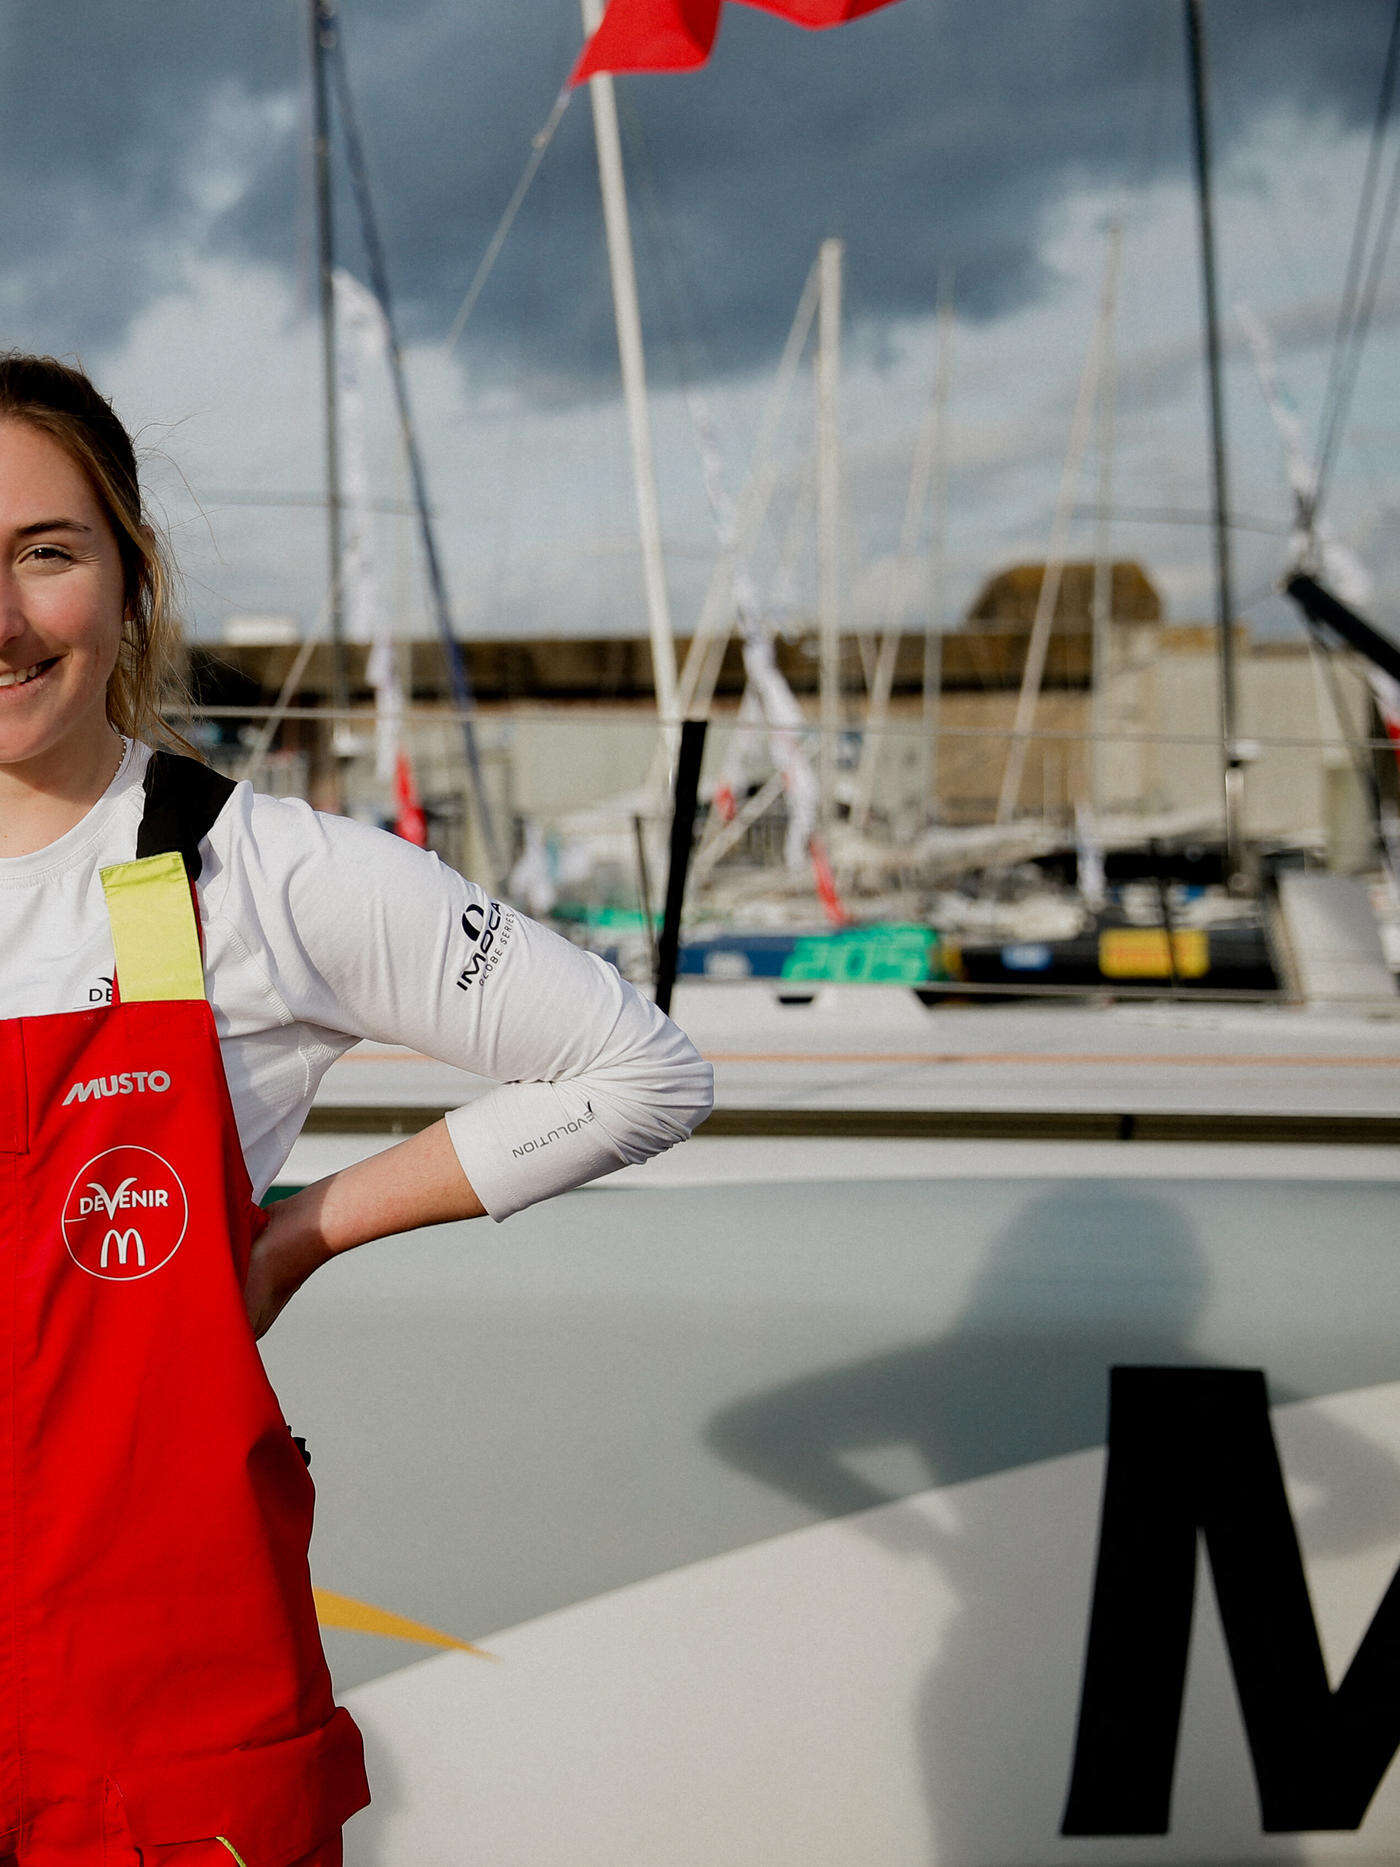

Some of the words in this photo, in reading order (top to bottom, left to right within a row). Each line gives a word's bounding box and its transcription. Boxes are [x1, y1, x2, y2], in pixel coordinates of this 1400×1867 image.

[456, 902, 501, 991] IMOCA
[478, 948, 503, 986] GLOBE
[500, 912, 515, 946] SERIES
[61, 1070, 171, 1106] MUSTO
[511, 1110, 596, 1159] EVOLUTION
[79, 1177, 169, 1221] DEVENIR
